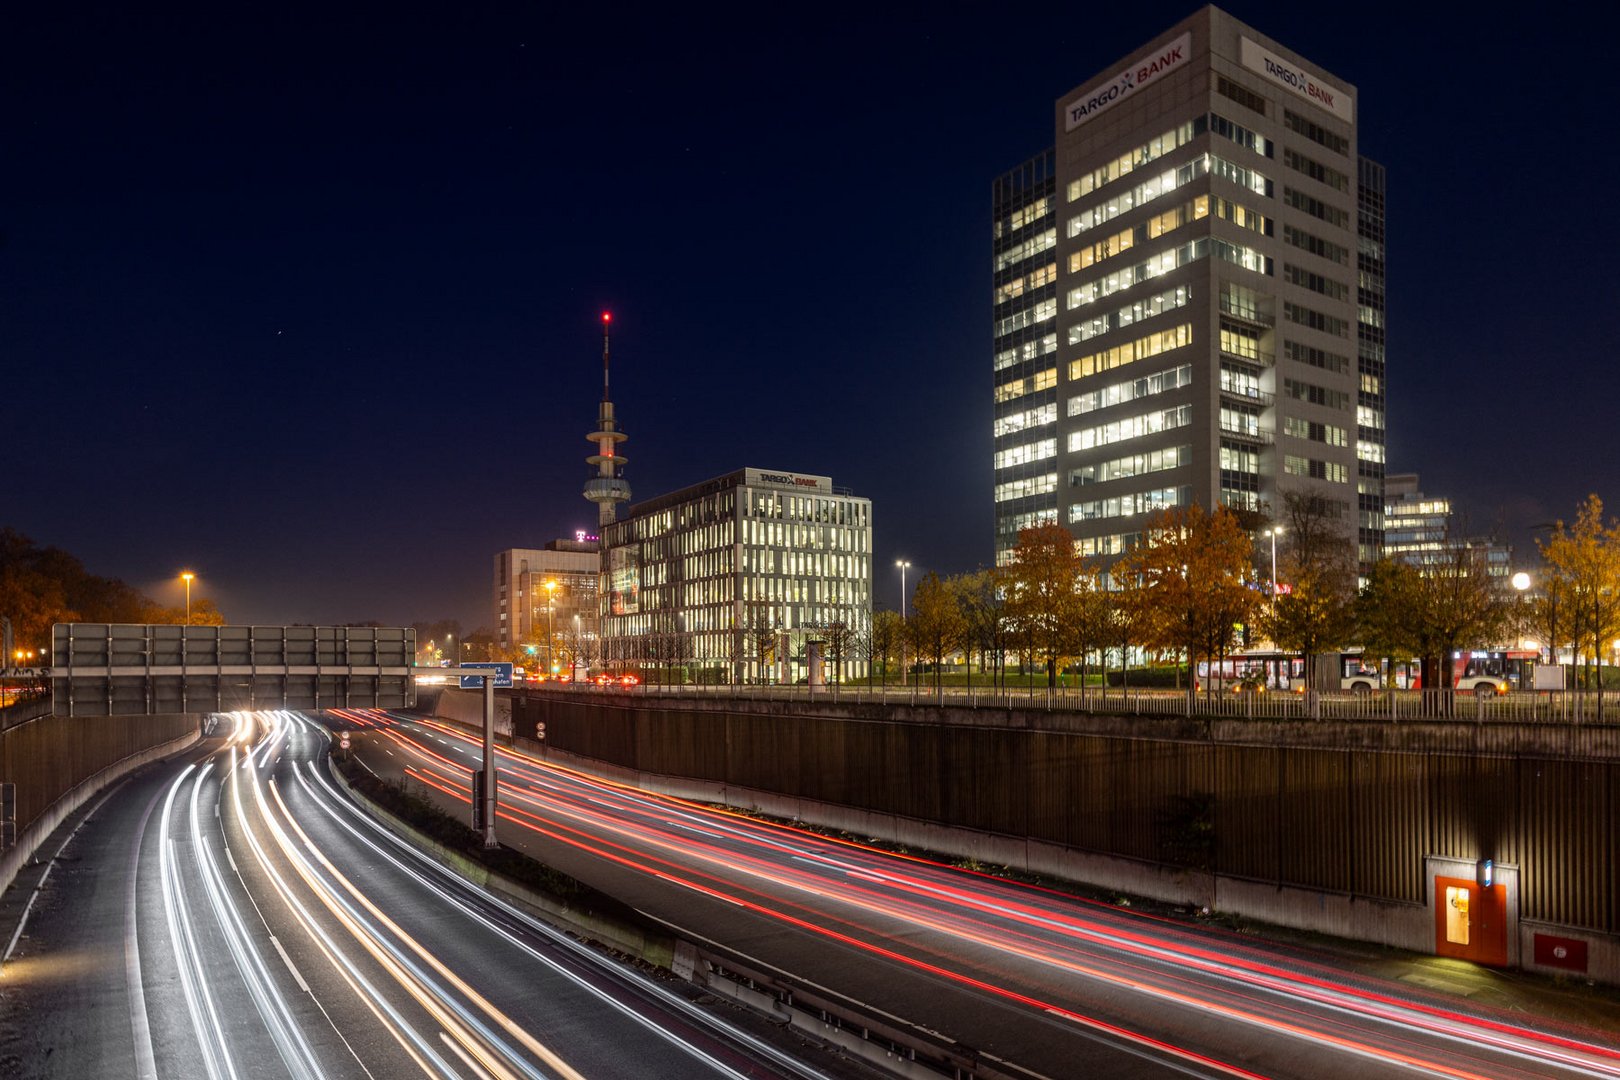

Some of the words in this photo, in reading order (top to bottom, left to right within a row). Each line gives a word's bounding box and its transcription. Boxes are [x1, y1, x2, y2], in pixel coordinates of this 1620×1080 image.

[1071, 84, 1120, 122] TARGO
[1136, 46, 1183, 84] BANK
[1264, 57, 1298, 87] TARGO
[1307, 82, 1334, 109] BANK
[760, 474, 787, 484] TARGO
[795, 477, 817, 487] BANK
